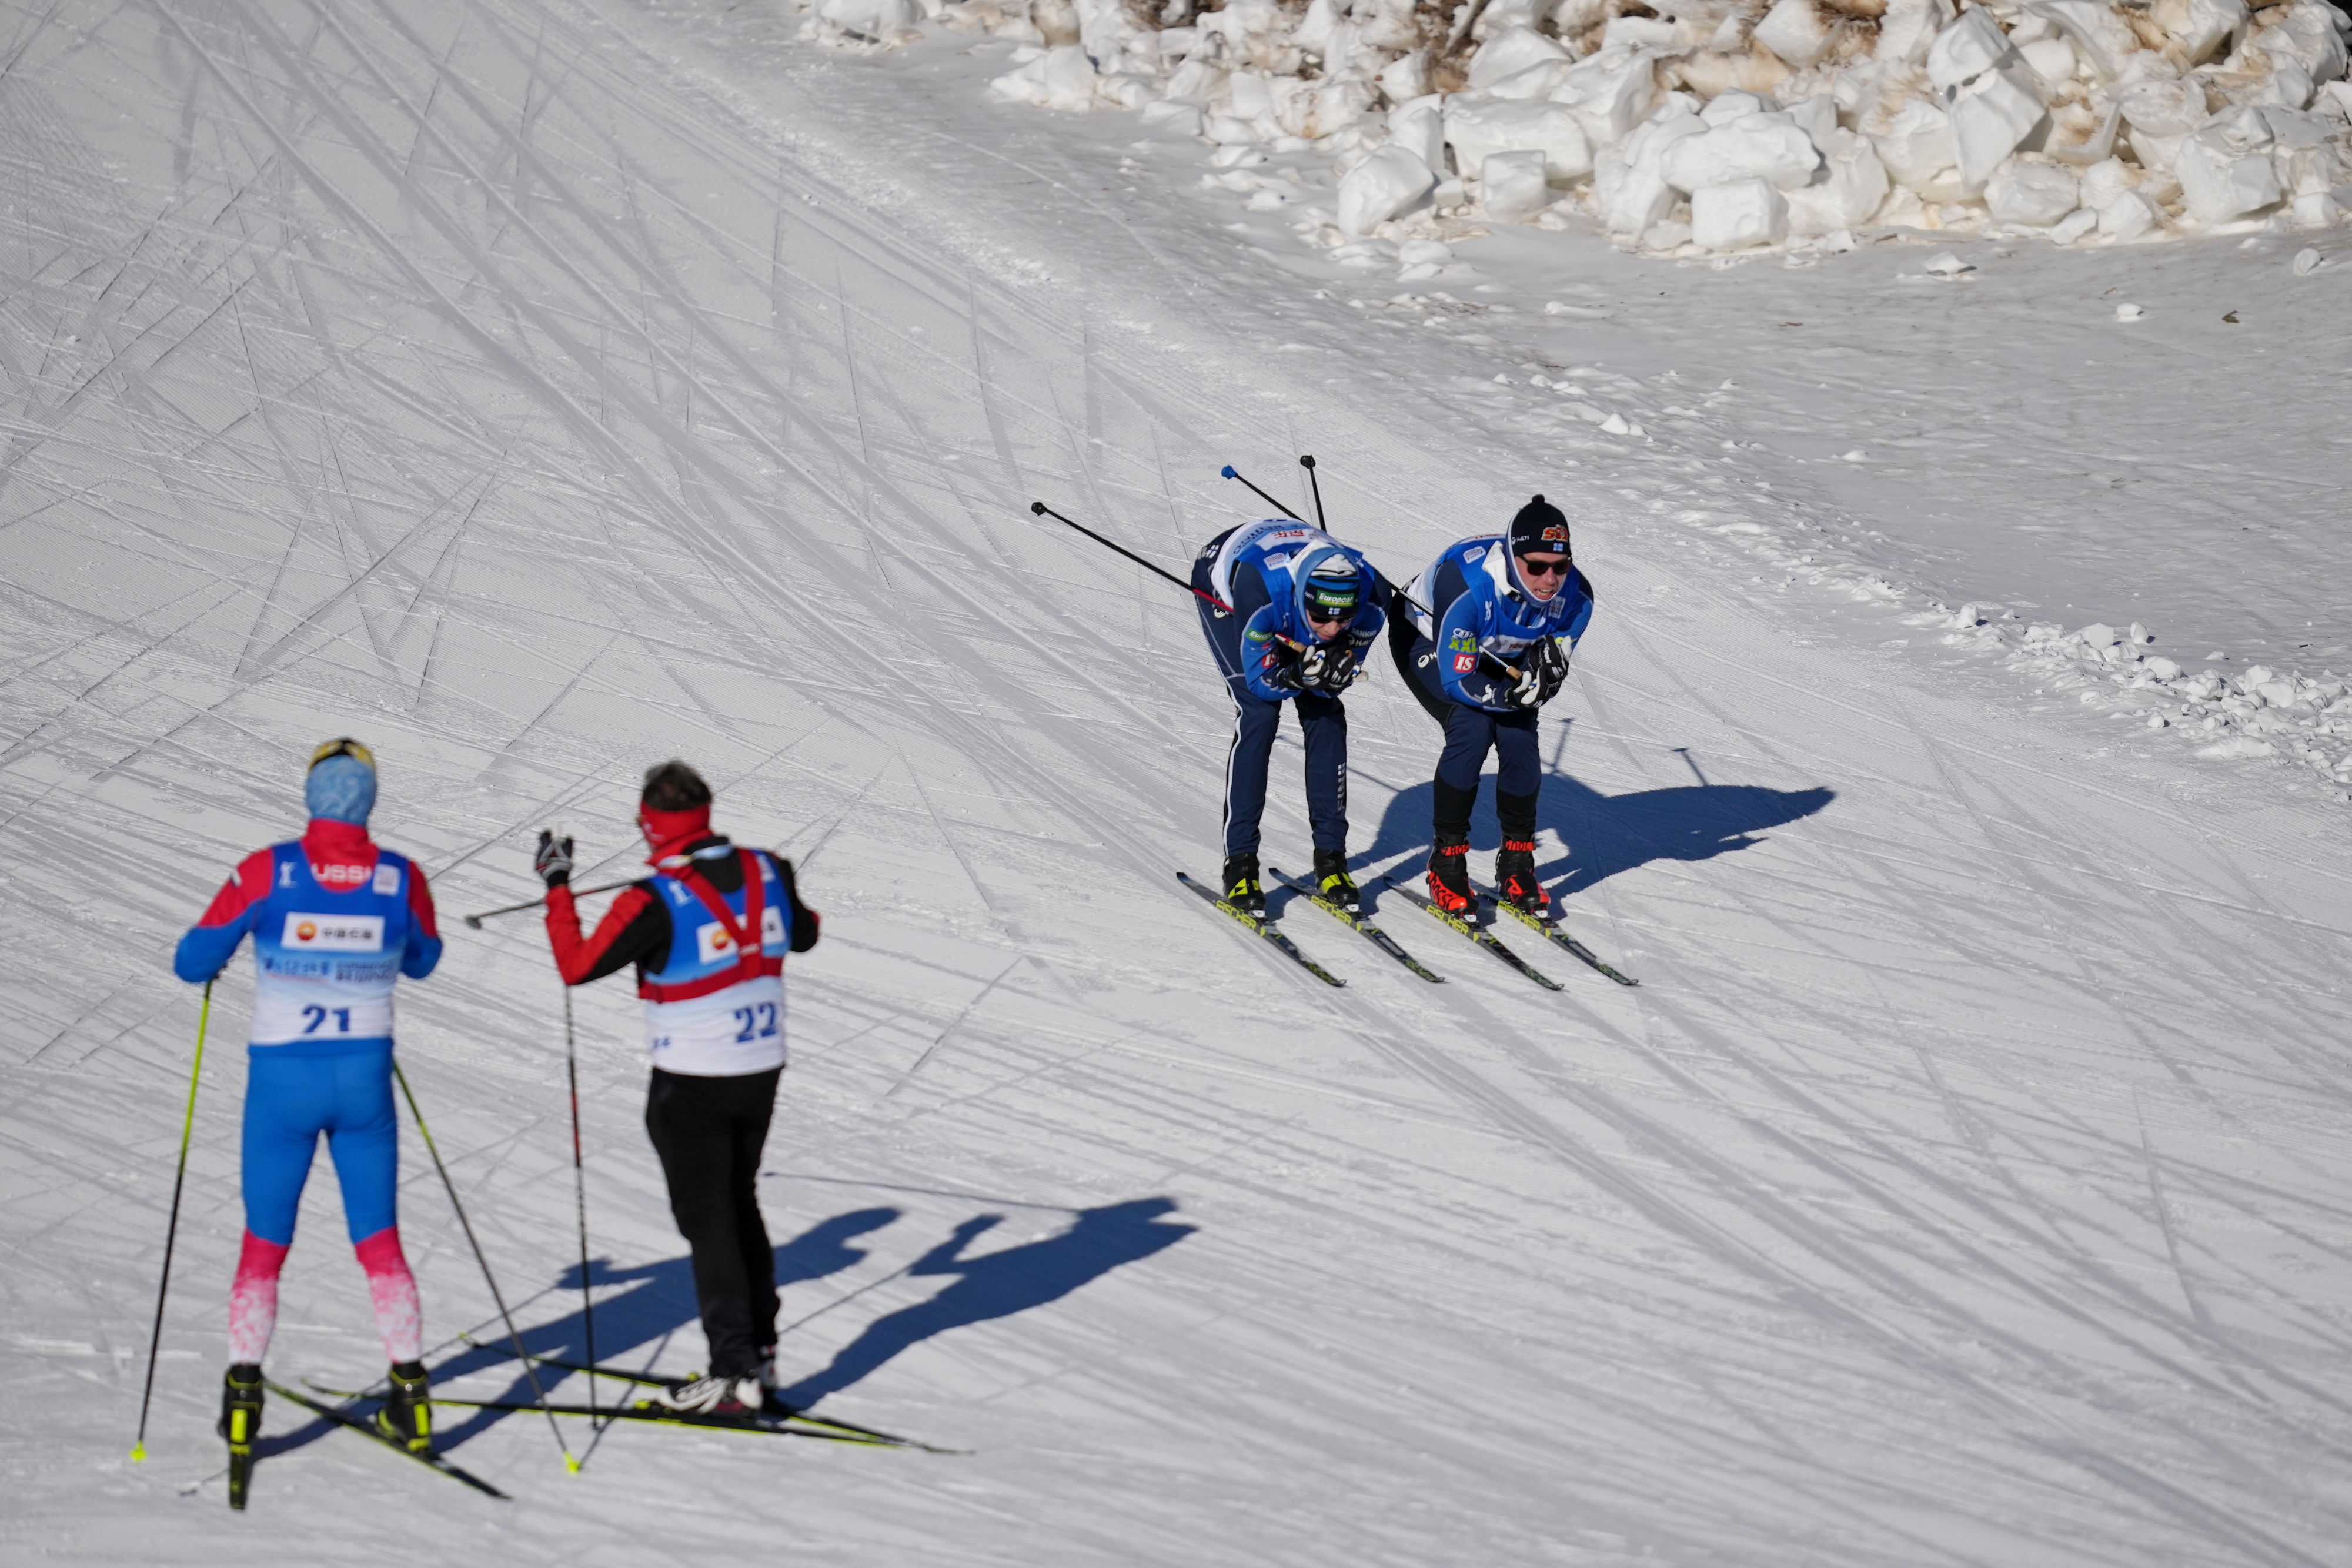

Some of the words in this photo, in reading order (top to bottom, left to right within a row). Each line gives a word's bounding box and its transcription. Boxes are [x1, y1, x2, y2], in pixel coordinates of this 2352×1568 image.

[1449, 637, 1478, 653] XXL
[1455, 656, 1474, 671] IS
[1215, 900, 1257, 930] FISCHER
[1311, 895, 1352, 926] FISCHER
[1426, 904, 1469, 936] FISCHER
[1498, 900, 1541, 932] FISCHER
[301, 1004, 350, 1034] 21
[733, 1002, 777, 1043] 22
